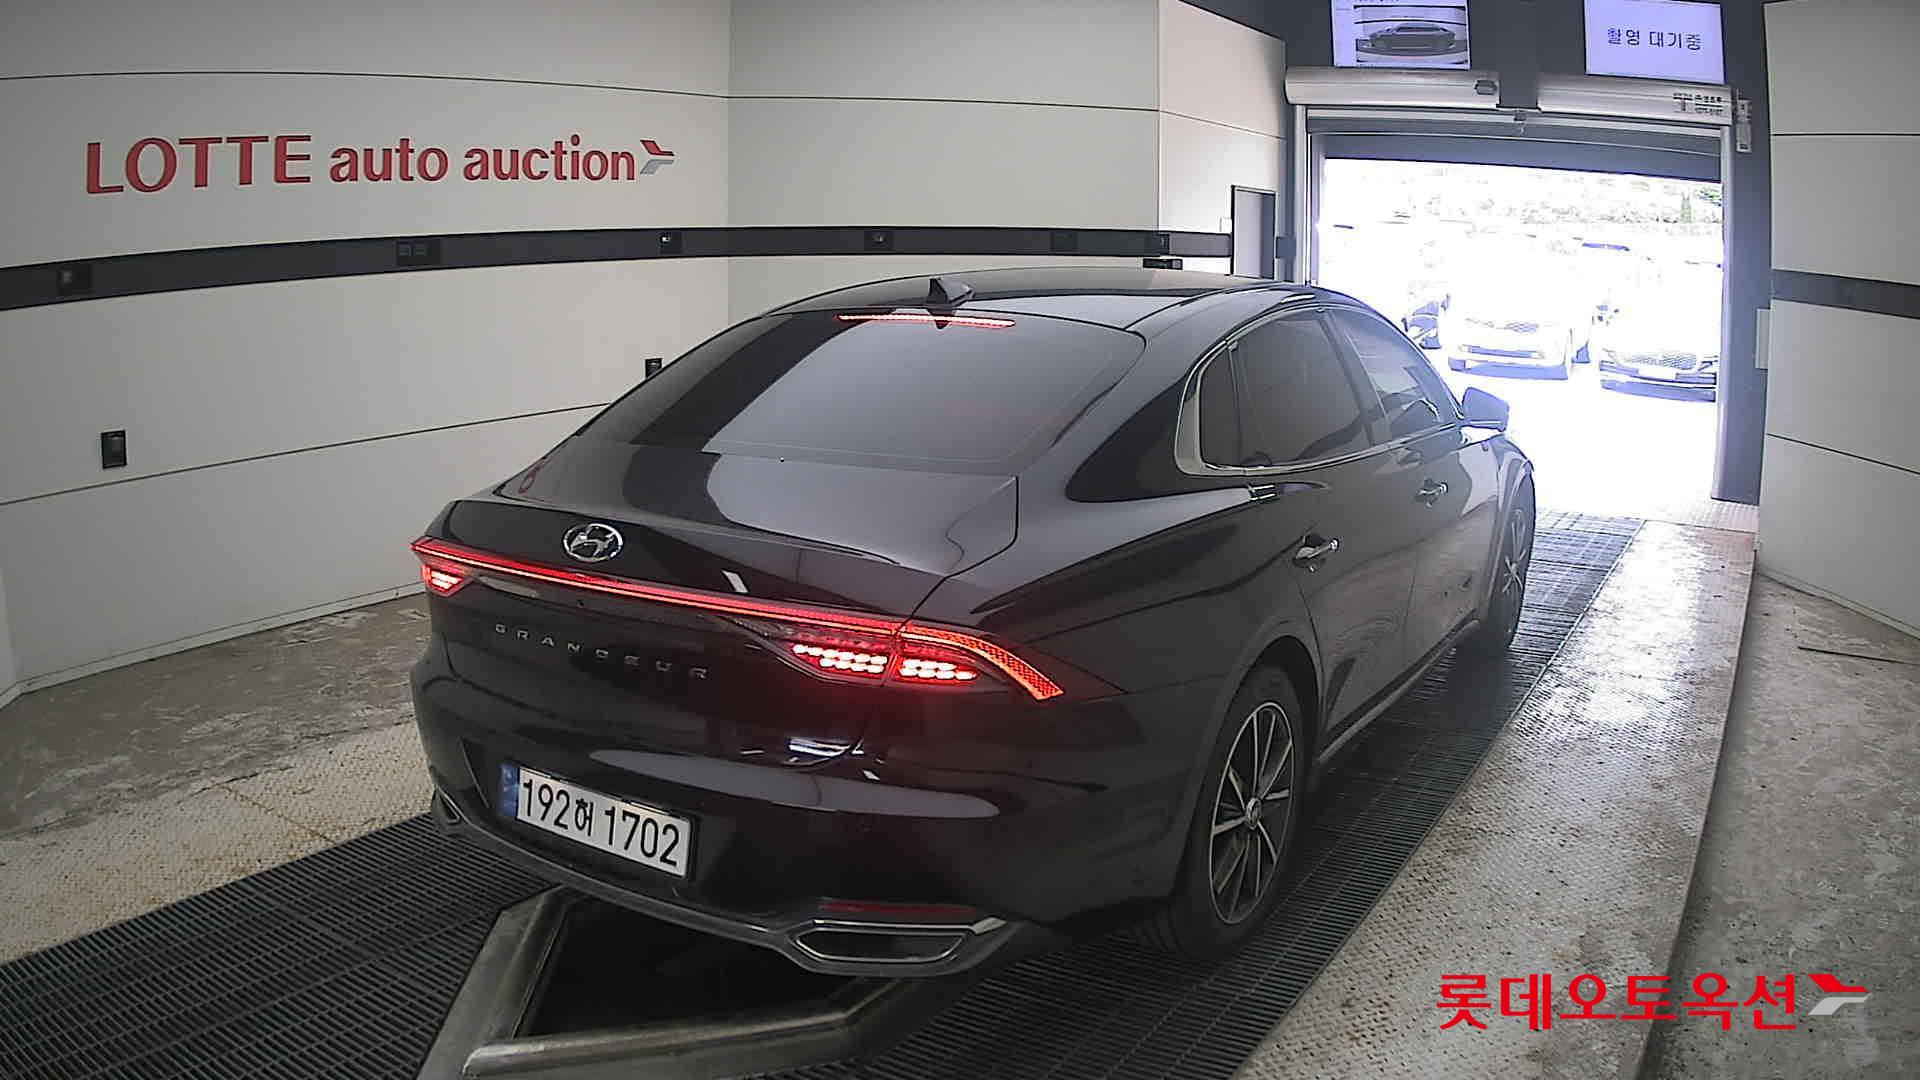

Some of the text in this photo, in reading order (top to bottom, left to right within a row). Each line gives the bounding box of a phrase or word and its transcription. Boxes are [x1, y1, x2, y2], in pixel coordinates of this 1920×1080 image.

[1648, 31, 1702, 51] 대기중
[86, 134, 637, 195] LOTTE auto auction
[494, 623, 710, 680] GRANDEUR
[604, 805, 680, 867] 1702
